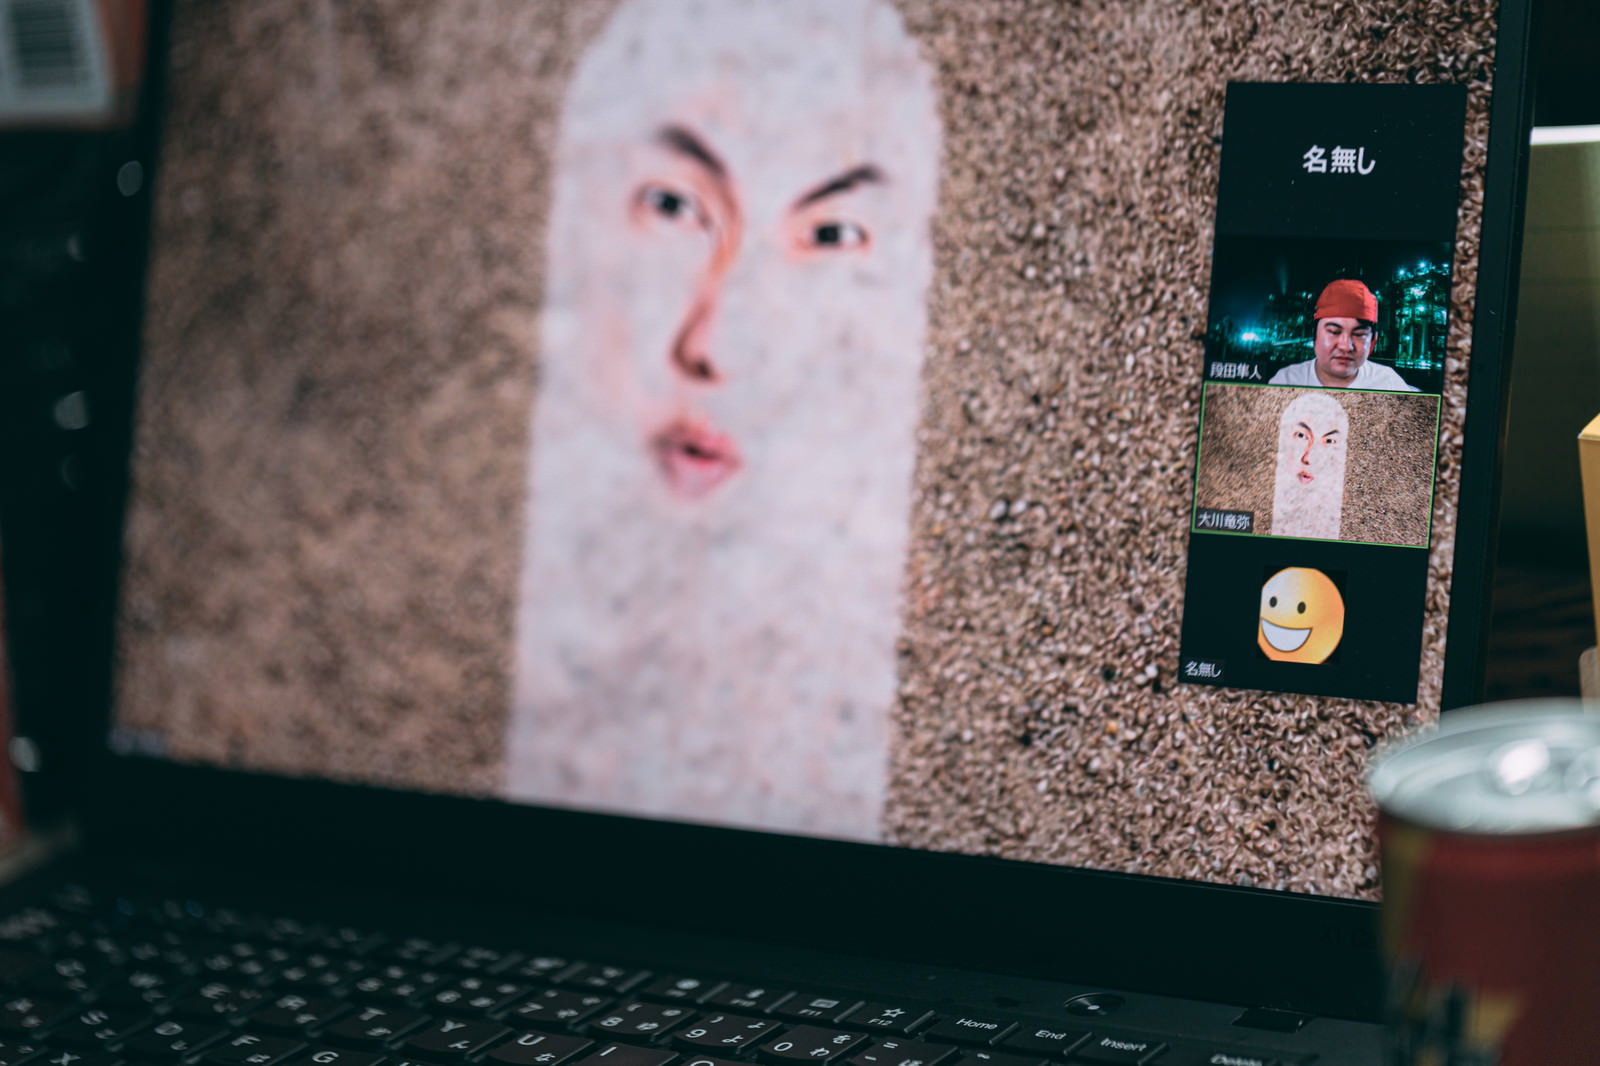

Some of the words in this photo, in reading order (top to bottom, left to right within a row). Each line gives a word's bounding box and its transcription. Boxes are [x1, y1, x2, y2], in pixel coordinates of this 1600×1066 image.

[1303, 145, 1375, 175] 名無し
[1186, 661, 1221, 677] 名無し
[440, 1020, 466, 1033] Y
[600, 1016, 624, 1027] 8
[867, 1017, 894, 1027] F12
[955, 1018, 998, 1030] Home
[685, 1028, 707, 1039] 9
[1034, 1029, 1067, 1040] End
[231, 1035, 261, 1046] F
[517, 1033, 546, 1046] U
[1100, 1037, 1147, 1052] Insert
[599, 1046, 617, 1057] I
[773, 1041, 793, 1052] 0
[311, 1051, 339, 1064] G
